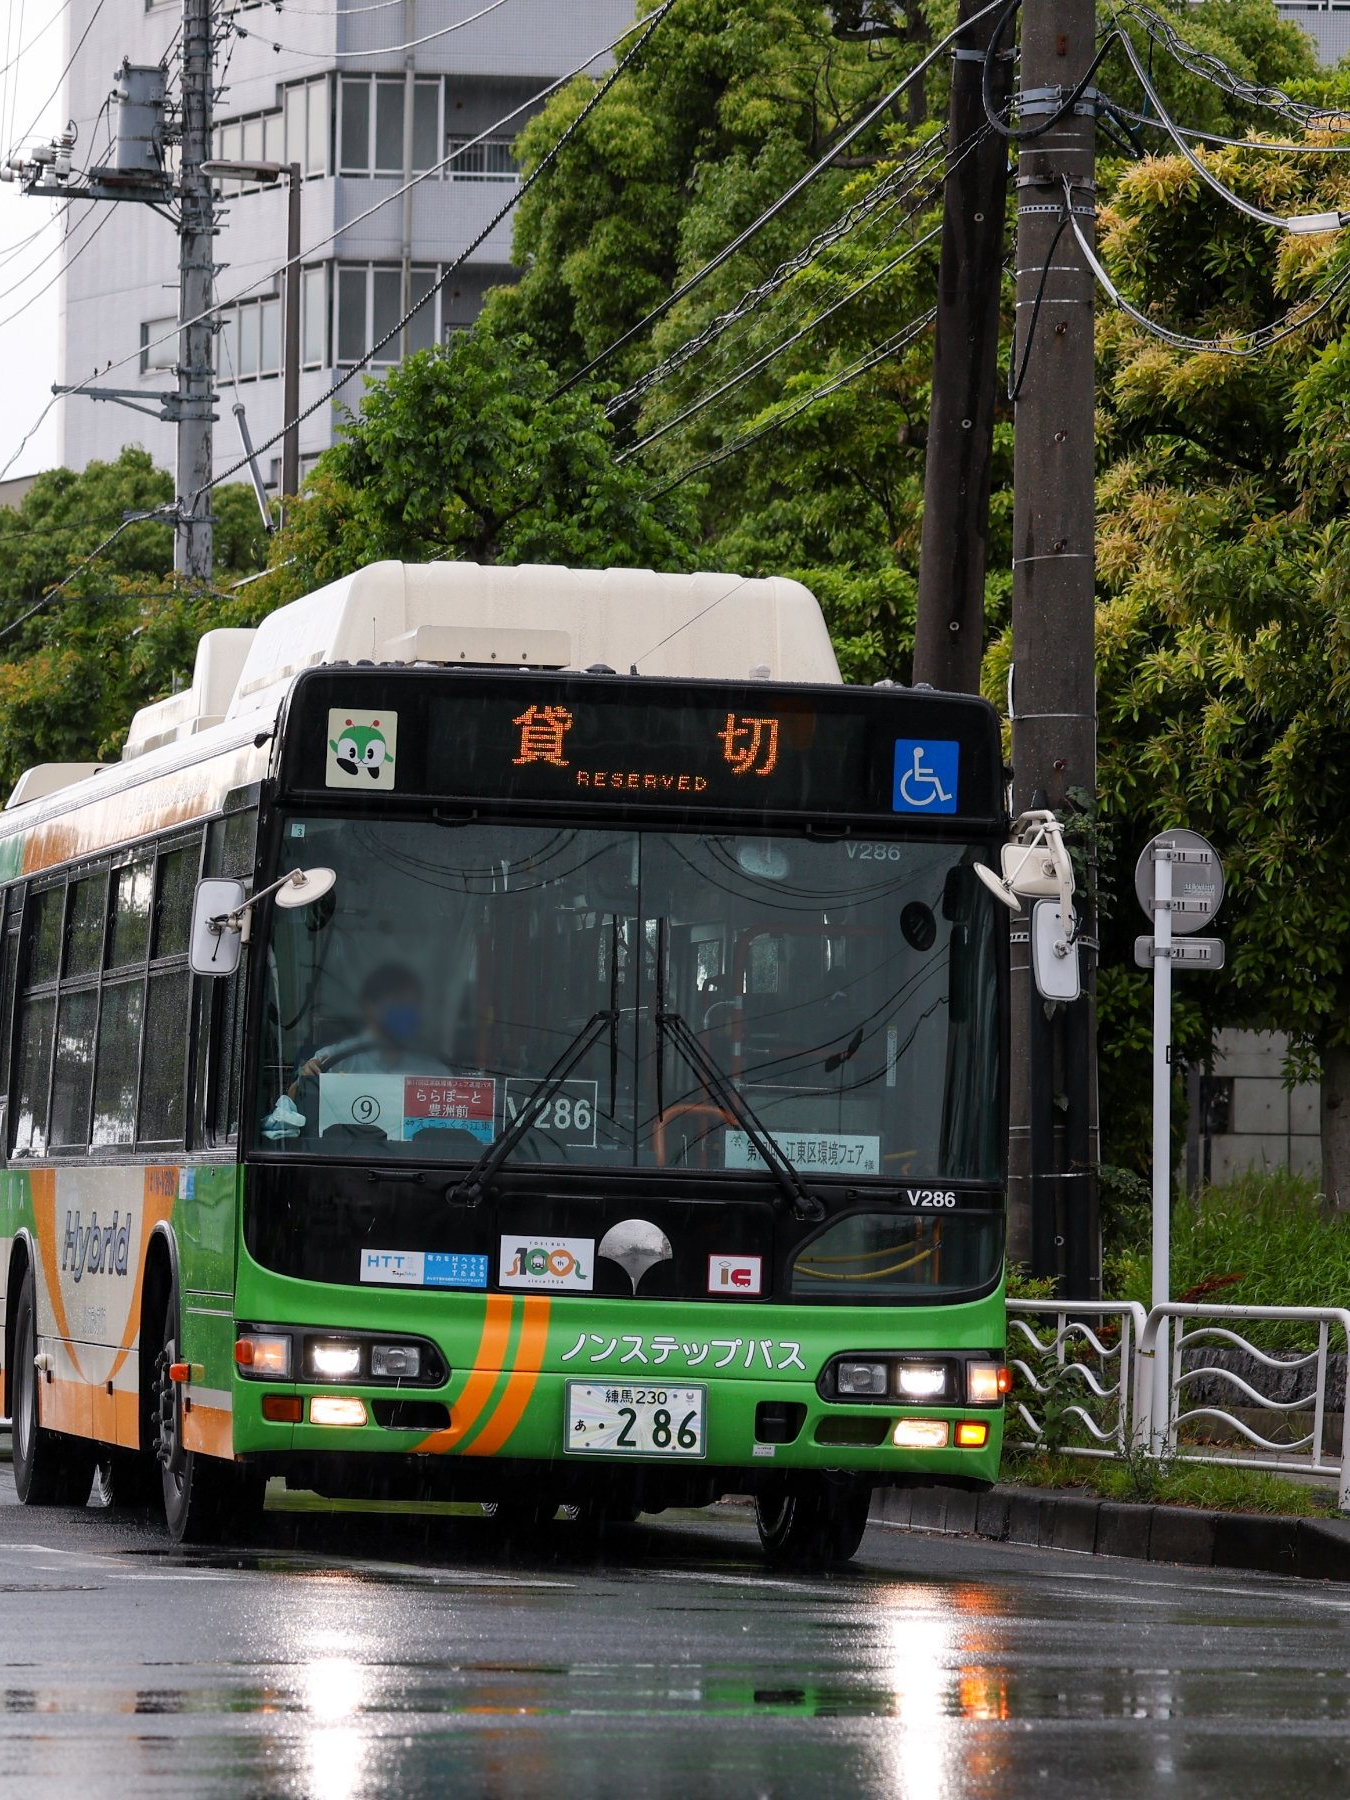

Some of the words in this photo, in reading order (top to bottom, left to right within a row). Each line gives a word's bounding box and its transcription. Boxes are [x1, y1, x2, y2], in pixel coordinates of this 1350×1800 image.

[512, 705, 573, 766] 貸
[718, 713, 778, 775] 切
[576, 770, 707, 791] RESERVED
[845, 842, 901, 860] V286
[416, 1089, 481, 1104] ららぽーと
[428, 1104, 469, 1118] 豊洲前
[506, 1096, 591, 1130] V286
[786, 1140, 864, 1166] 江東区環境フェア
[906, 1190, 956, 1208] V286
[62, 1210, 132, 1283] Hybrid
[367, 1255, 405, 1269] HTT
[561, 1333, 806, 1370] ノンステップバス
[574, 1419, 586, 1432] あ
